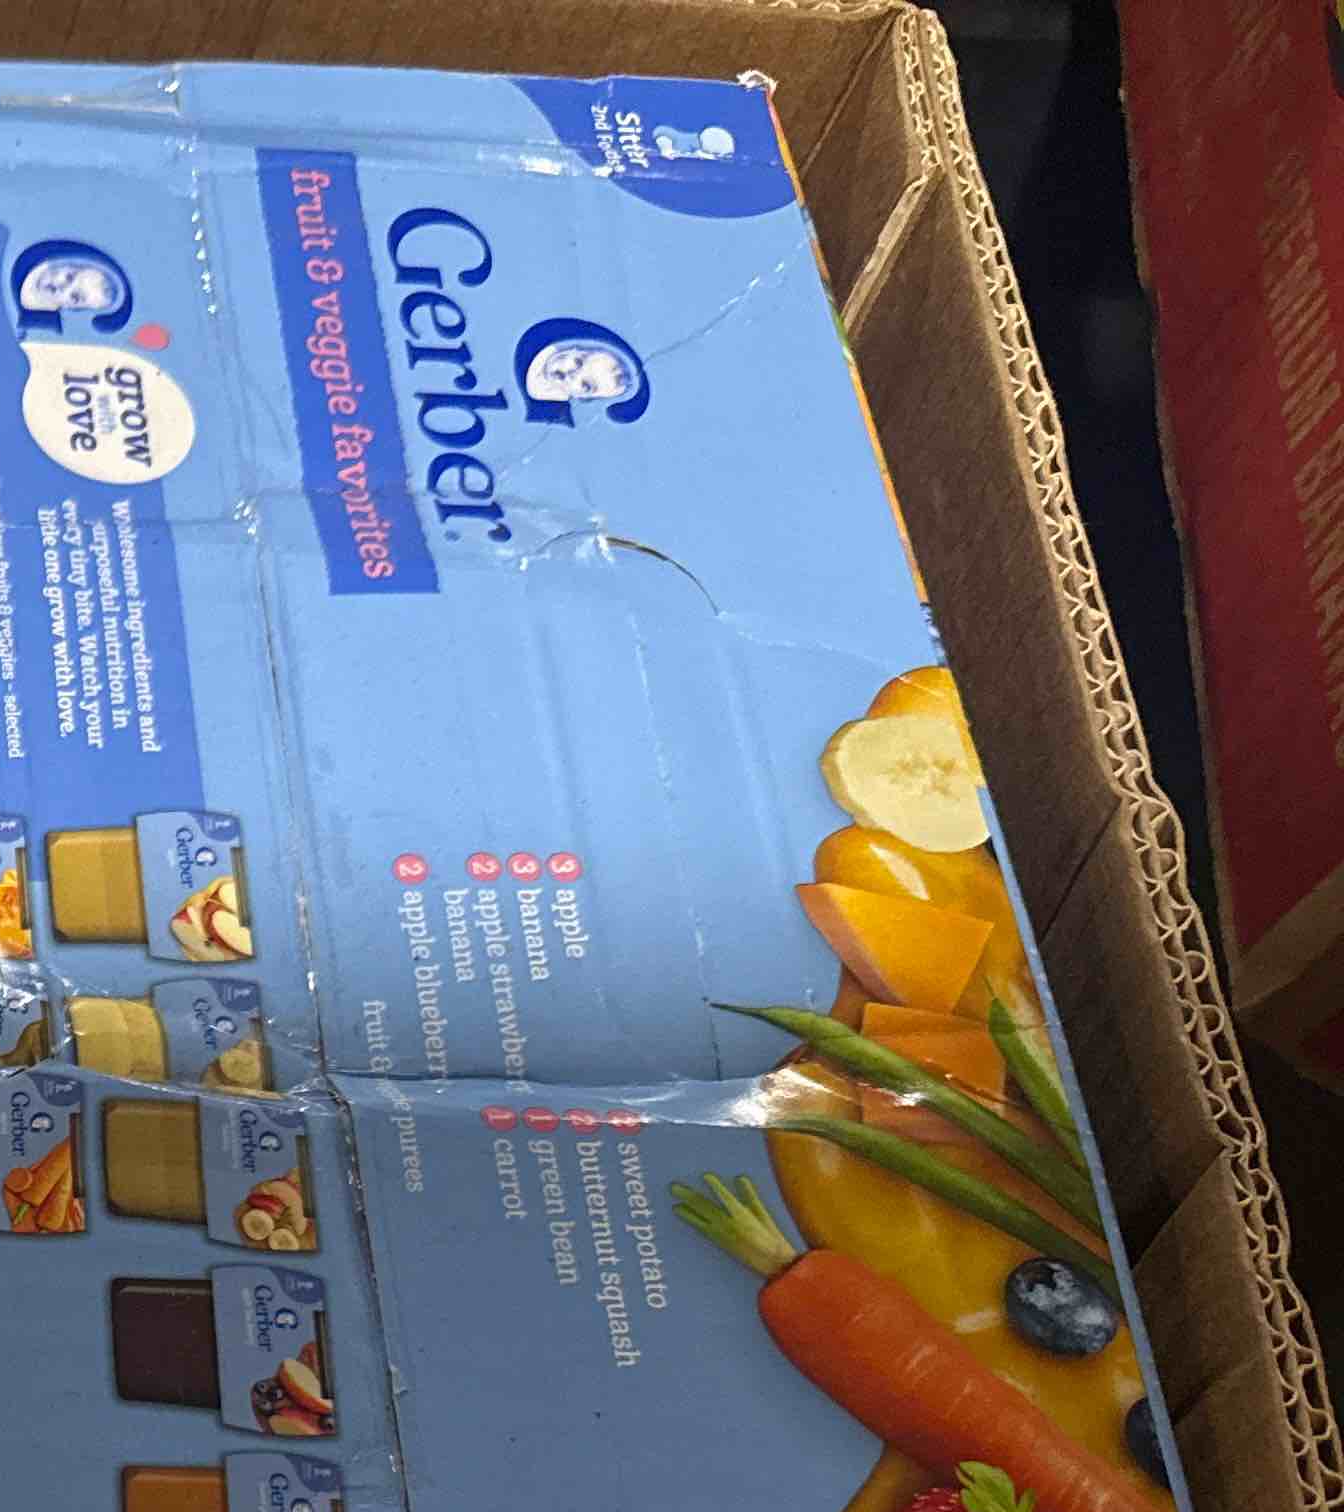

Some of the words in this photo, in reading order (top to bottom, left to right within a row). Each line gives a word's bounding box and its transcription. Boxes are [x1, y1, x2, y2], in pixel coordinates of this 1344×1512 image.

[292, 169, 333, 248] fruit
[307, 258, 343, 281] &
[310, 291, 366, 414] veggie
[63, 374, 97, 450] love
[105, 367, 151, 465] grow
[42, 550, 60, 583] one
[63, 550, 79, 586] tiny
[87, 521, 117, 613] urposeful
[42, 585, 61, 636] grow
[73, 589, 94, 630] bite.
[50, 638, 72, 685] with
[76, 635, 100, 696] Watch
[101, 617, 126, 706] nutrition
[119, 600, 155, 711] ingredients
[137, 714, 159, 752] and
[55, 688, 77, 736] love.
[80, 701, 104, 749] your
[111, 707, 129, 728] in
[397, 890, 432, 957] apple
[443, 888, 473, 980] banana
[472, 888, 506, 955] apple
[516, 888, 548, 979] banana
[551, 888, 587, 956] apple
[362, 999, 386, 1048] fruit
[413, 964, 444, 1069] blueberr
[493, 1138, 527, 1218] carrot
[528, 1139, 565, 1213] green
[549, 1221, 577, 1283] bean
[576, 1142, 616, 1264] butternut
[600, 1271, 641, 1367] squash
[618, 1143, 650, 1216] sweet
[637, 1224, 666, 1309] potato
